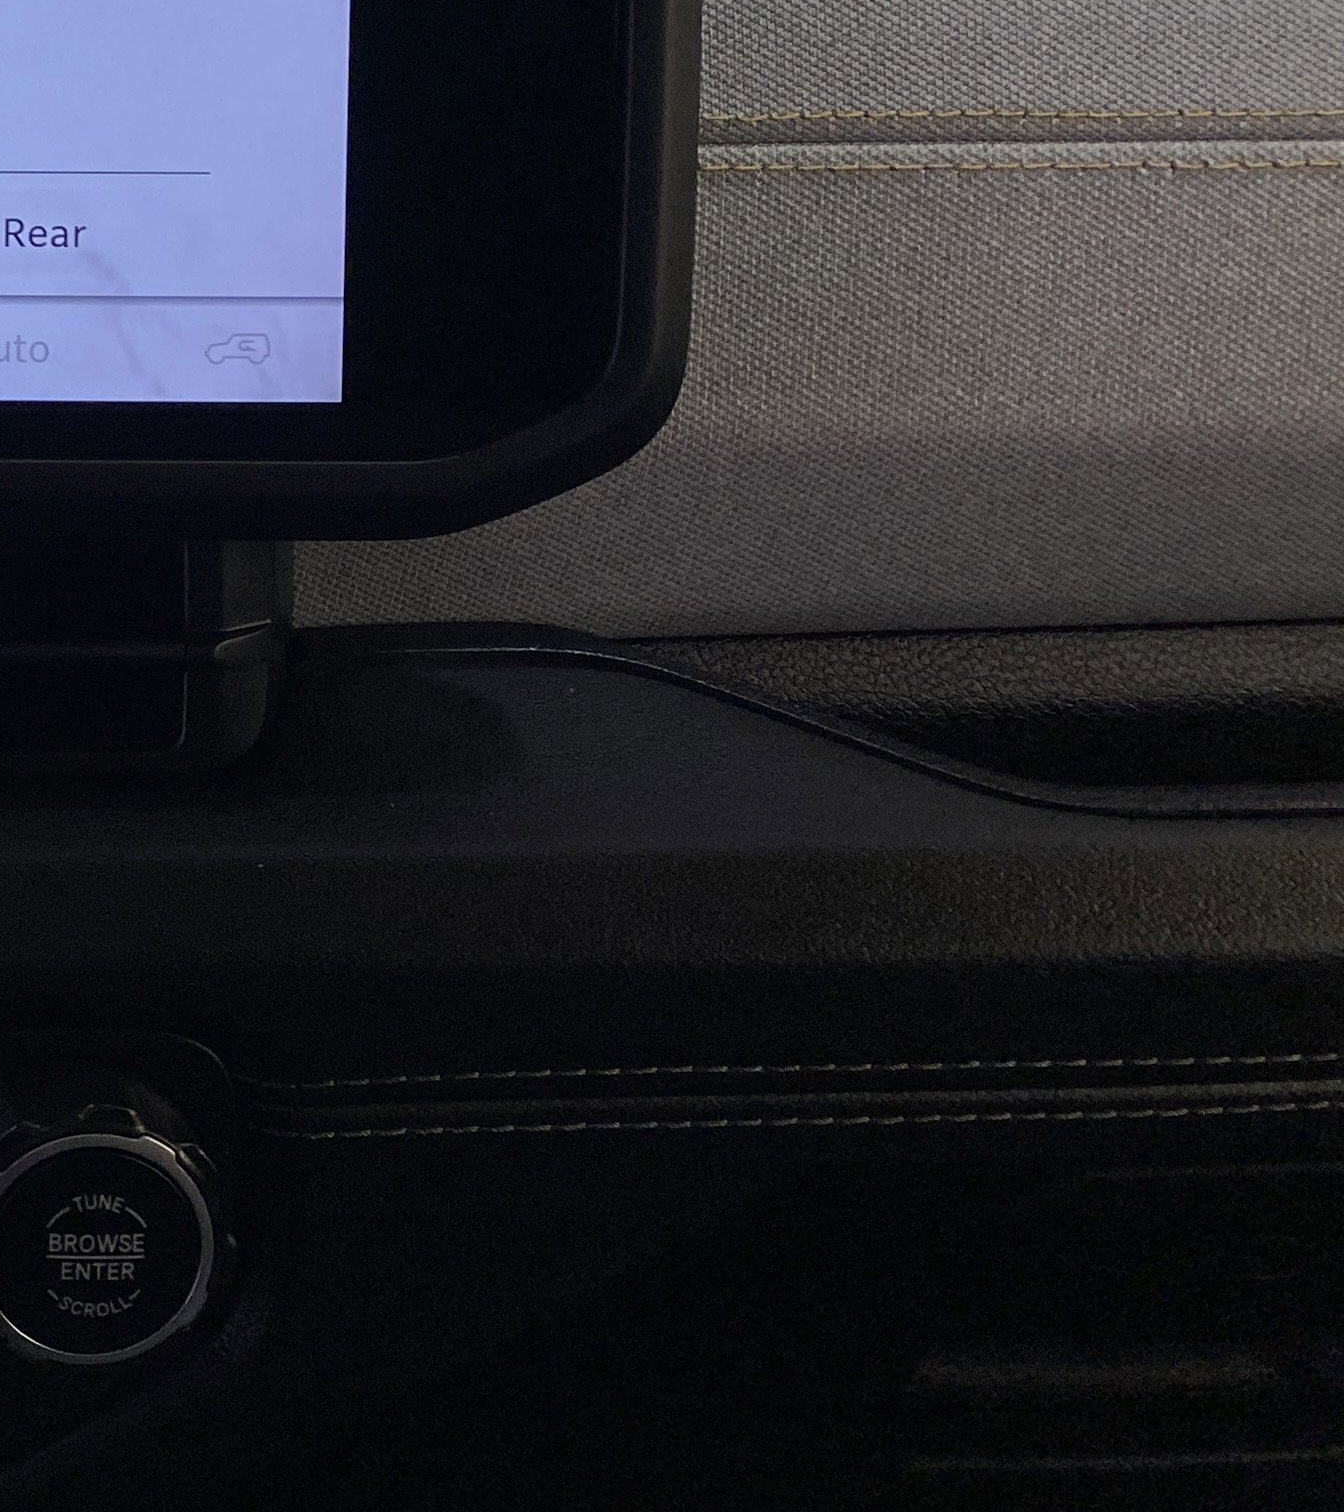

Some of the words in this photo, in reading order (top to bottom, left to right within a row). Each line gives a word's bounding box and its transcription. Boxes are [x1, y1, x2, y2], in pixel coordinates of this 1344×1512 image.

[3, 216, 87, 250] Rear
[72, 1194, 125, 1214] TUNE
[49, 1233, 145, 1254] BROWSE
[61, 1262, 135, 1280] ENTER
[57, 1296, 133, 1318] SCROLL
